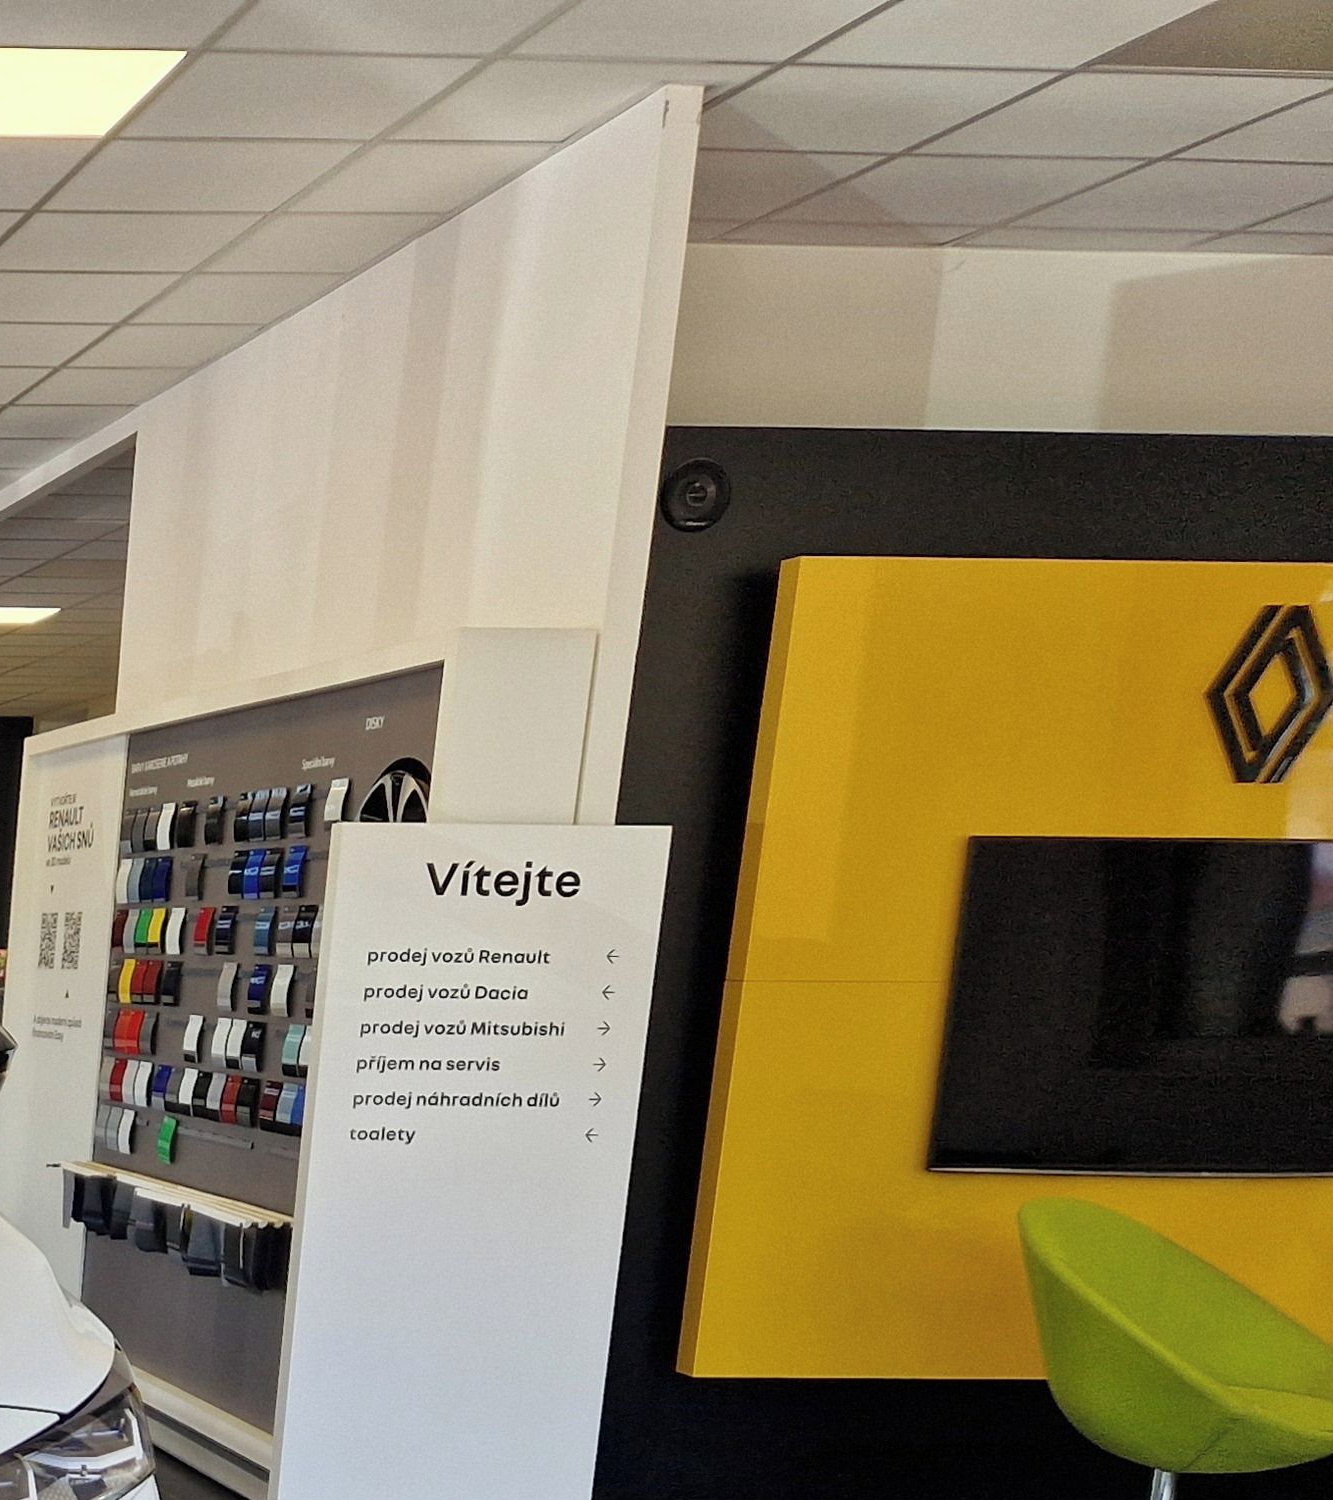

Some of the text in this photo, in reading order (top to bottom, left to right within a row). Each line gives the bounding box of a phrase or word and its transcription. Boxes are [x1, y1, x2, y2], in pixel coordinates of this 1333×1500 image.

[365, 716, 385, 730] DISKY
[49, 806, 84, 829] RENAULT
[47, 829, 76, 852] VAŠICH
[426, 860, 581, 907] Vítejte
[368, 948, 550, 966] prodej vozů Renault
[364, 984, 528, 1002] prodej vozů Dacia
[360, 1020, 565, 1038] prodej vozů Mitsubishi
[356, 1056, 500, 1073] příjem na servis
[353, 1092, 560, 1109] prodej náhradních dílů
[350, 1127, 415, 1145] toalety
